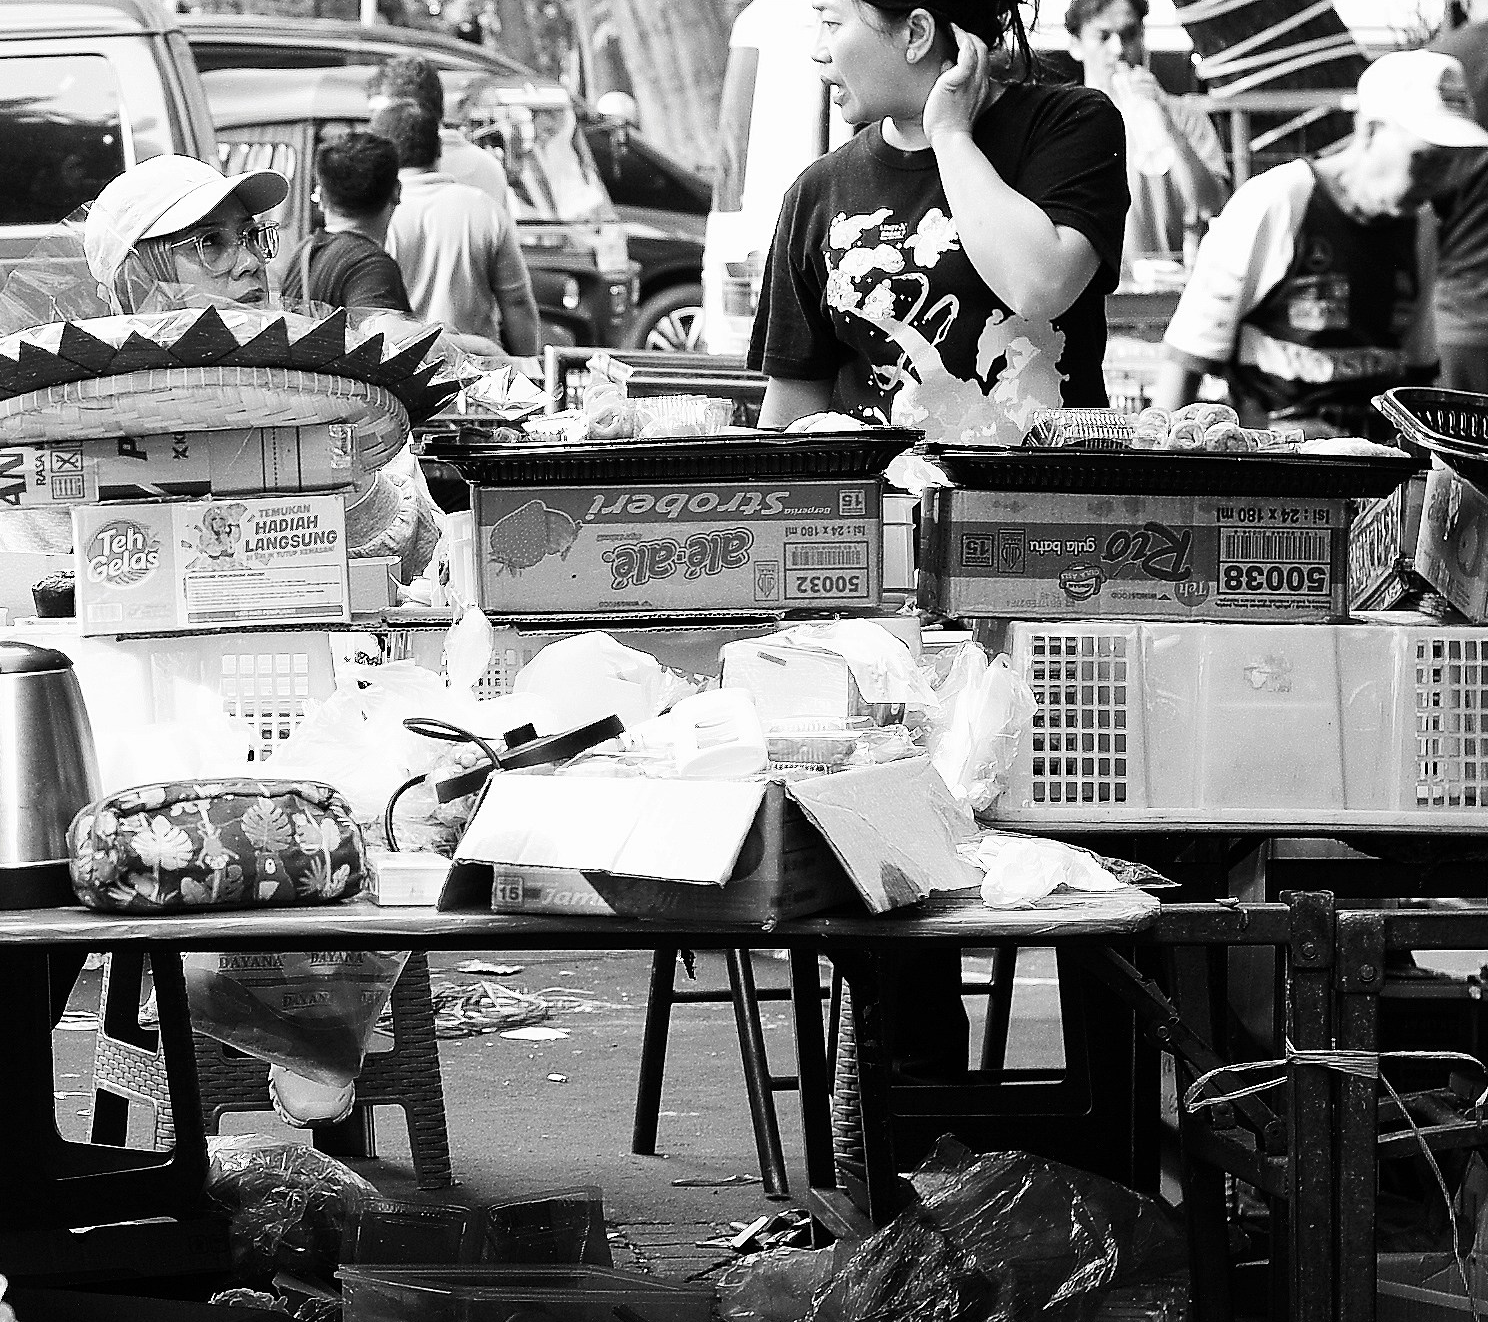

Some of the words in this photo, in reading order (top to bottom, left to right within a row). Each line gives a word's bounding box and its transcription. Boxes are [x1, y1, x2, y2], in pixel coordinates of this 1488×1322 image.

[585, 490, 791, 521] Stroberi
[841, 493, 864, 509] 15
[258, 503, 311, 519] TEMUKAN
[1216, 507, 1236, 523] ml
[1238, 507, 1265, 523] 180
[1282, 507, 1300, 522] 24
[1316, 507, 1331, 522] Isi
[253, 515, 319, 536] HADIAH
[784, 525, 798, 538] ml
[800, 525, 820, 538] 180
[831, 525, 845, 538] 24
[853, 525, 866, 538] Isi
[96, 526, 144, 556] Teh
[244, 529, 339, 553] LANGSUNG
[965, 537, 990, 555] 15
[1029, 537, 1064, 556] batu
[1069, 537, 1096, 557] gula
[1100, 522, 1192, 582] Rio
[86, 546, 161, 584] Gelas
[795, 575, 861, 595] 50032
[1223, 565, 1326, 593] 50038
[1179, 582, 1211, 597] Teh
[498, 883, 519, 902] 15
[219, 954, 285, 969] DAYANA
